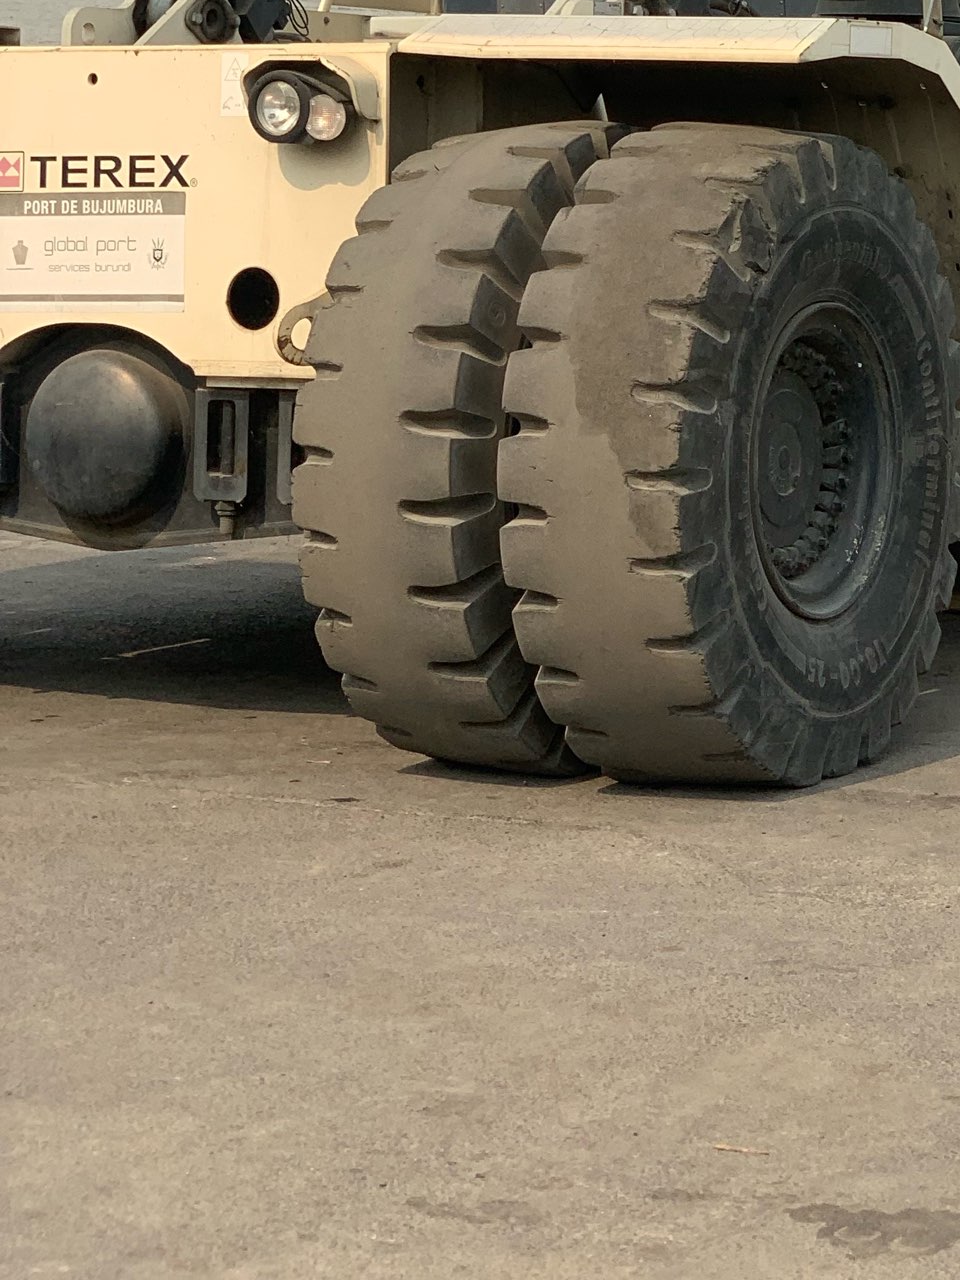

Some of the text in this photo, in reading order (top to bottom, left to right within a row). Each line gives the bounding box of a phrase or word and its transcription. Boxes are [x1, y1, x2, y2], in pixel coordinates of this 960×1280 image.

[30, 154, 190, 188] TEREX
[23, 199, 164, 214] PORT DE BUJUMBURA
[44, 236, 137, 256] global port
[48, 263, 132, 272] services burundi
